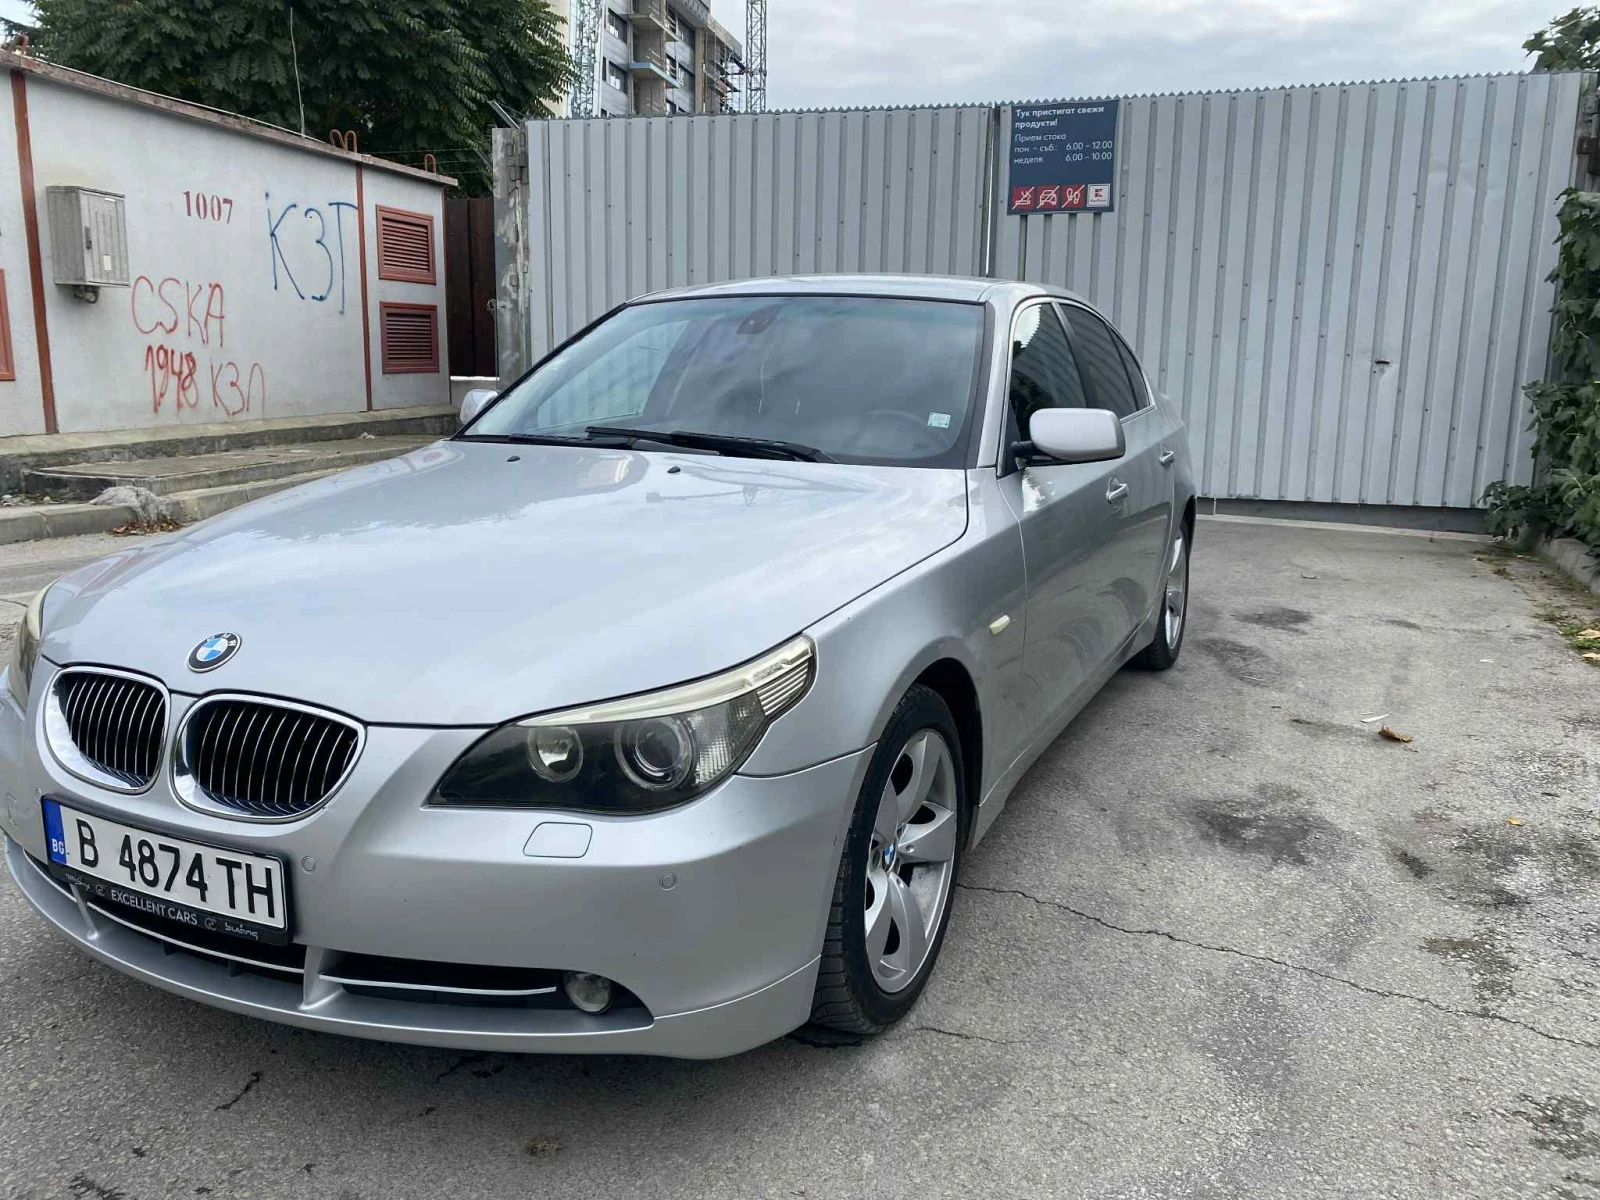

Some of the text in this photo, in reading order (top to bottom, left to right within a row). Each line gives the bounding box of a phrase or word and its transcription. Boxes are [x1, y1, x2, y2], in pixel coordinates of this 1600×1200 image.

[1016, 106, 1105, 118] Тук пристигат свежи
[1015, 119, 1058, 129] продукти!
[1014, 134, 1042, 143] Прием
[1066, 142, 1084, 151] 6.00
[1092, 141, 1113, 150] 12.00
[1065, 153, 1083, 162] 6.00
[1091, 151, 1113, 160] 10.00
[183, 190, 233, 224] 1007
[132, 275, 225, 348] CSKA
[145, 344, 199, 414] 1948
[52, 838, 65, 855] BG
[76, 818, 275, 919] B 4874 TH
[111, 889, 166, 916] EXCELLENT
[168, 907, 198, 926] CARS
